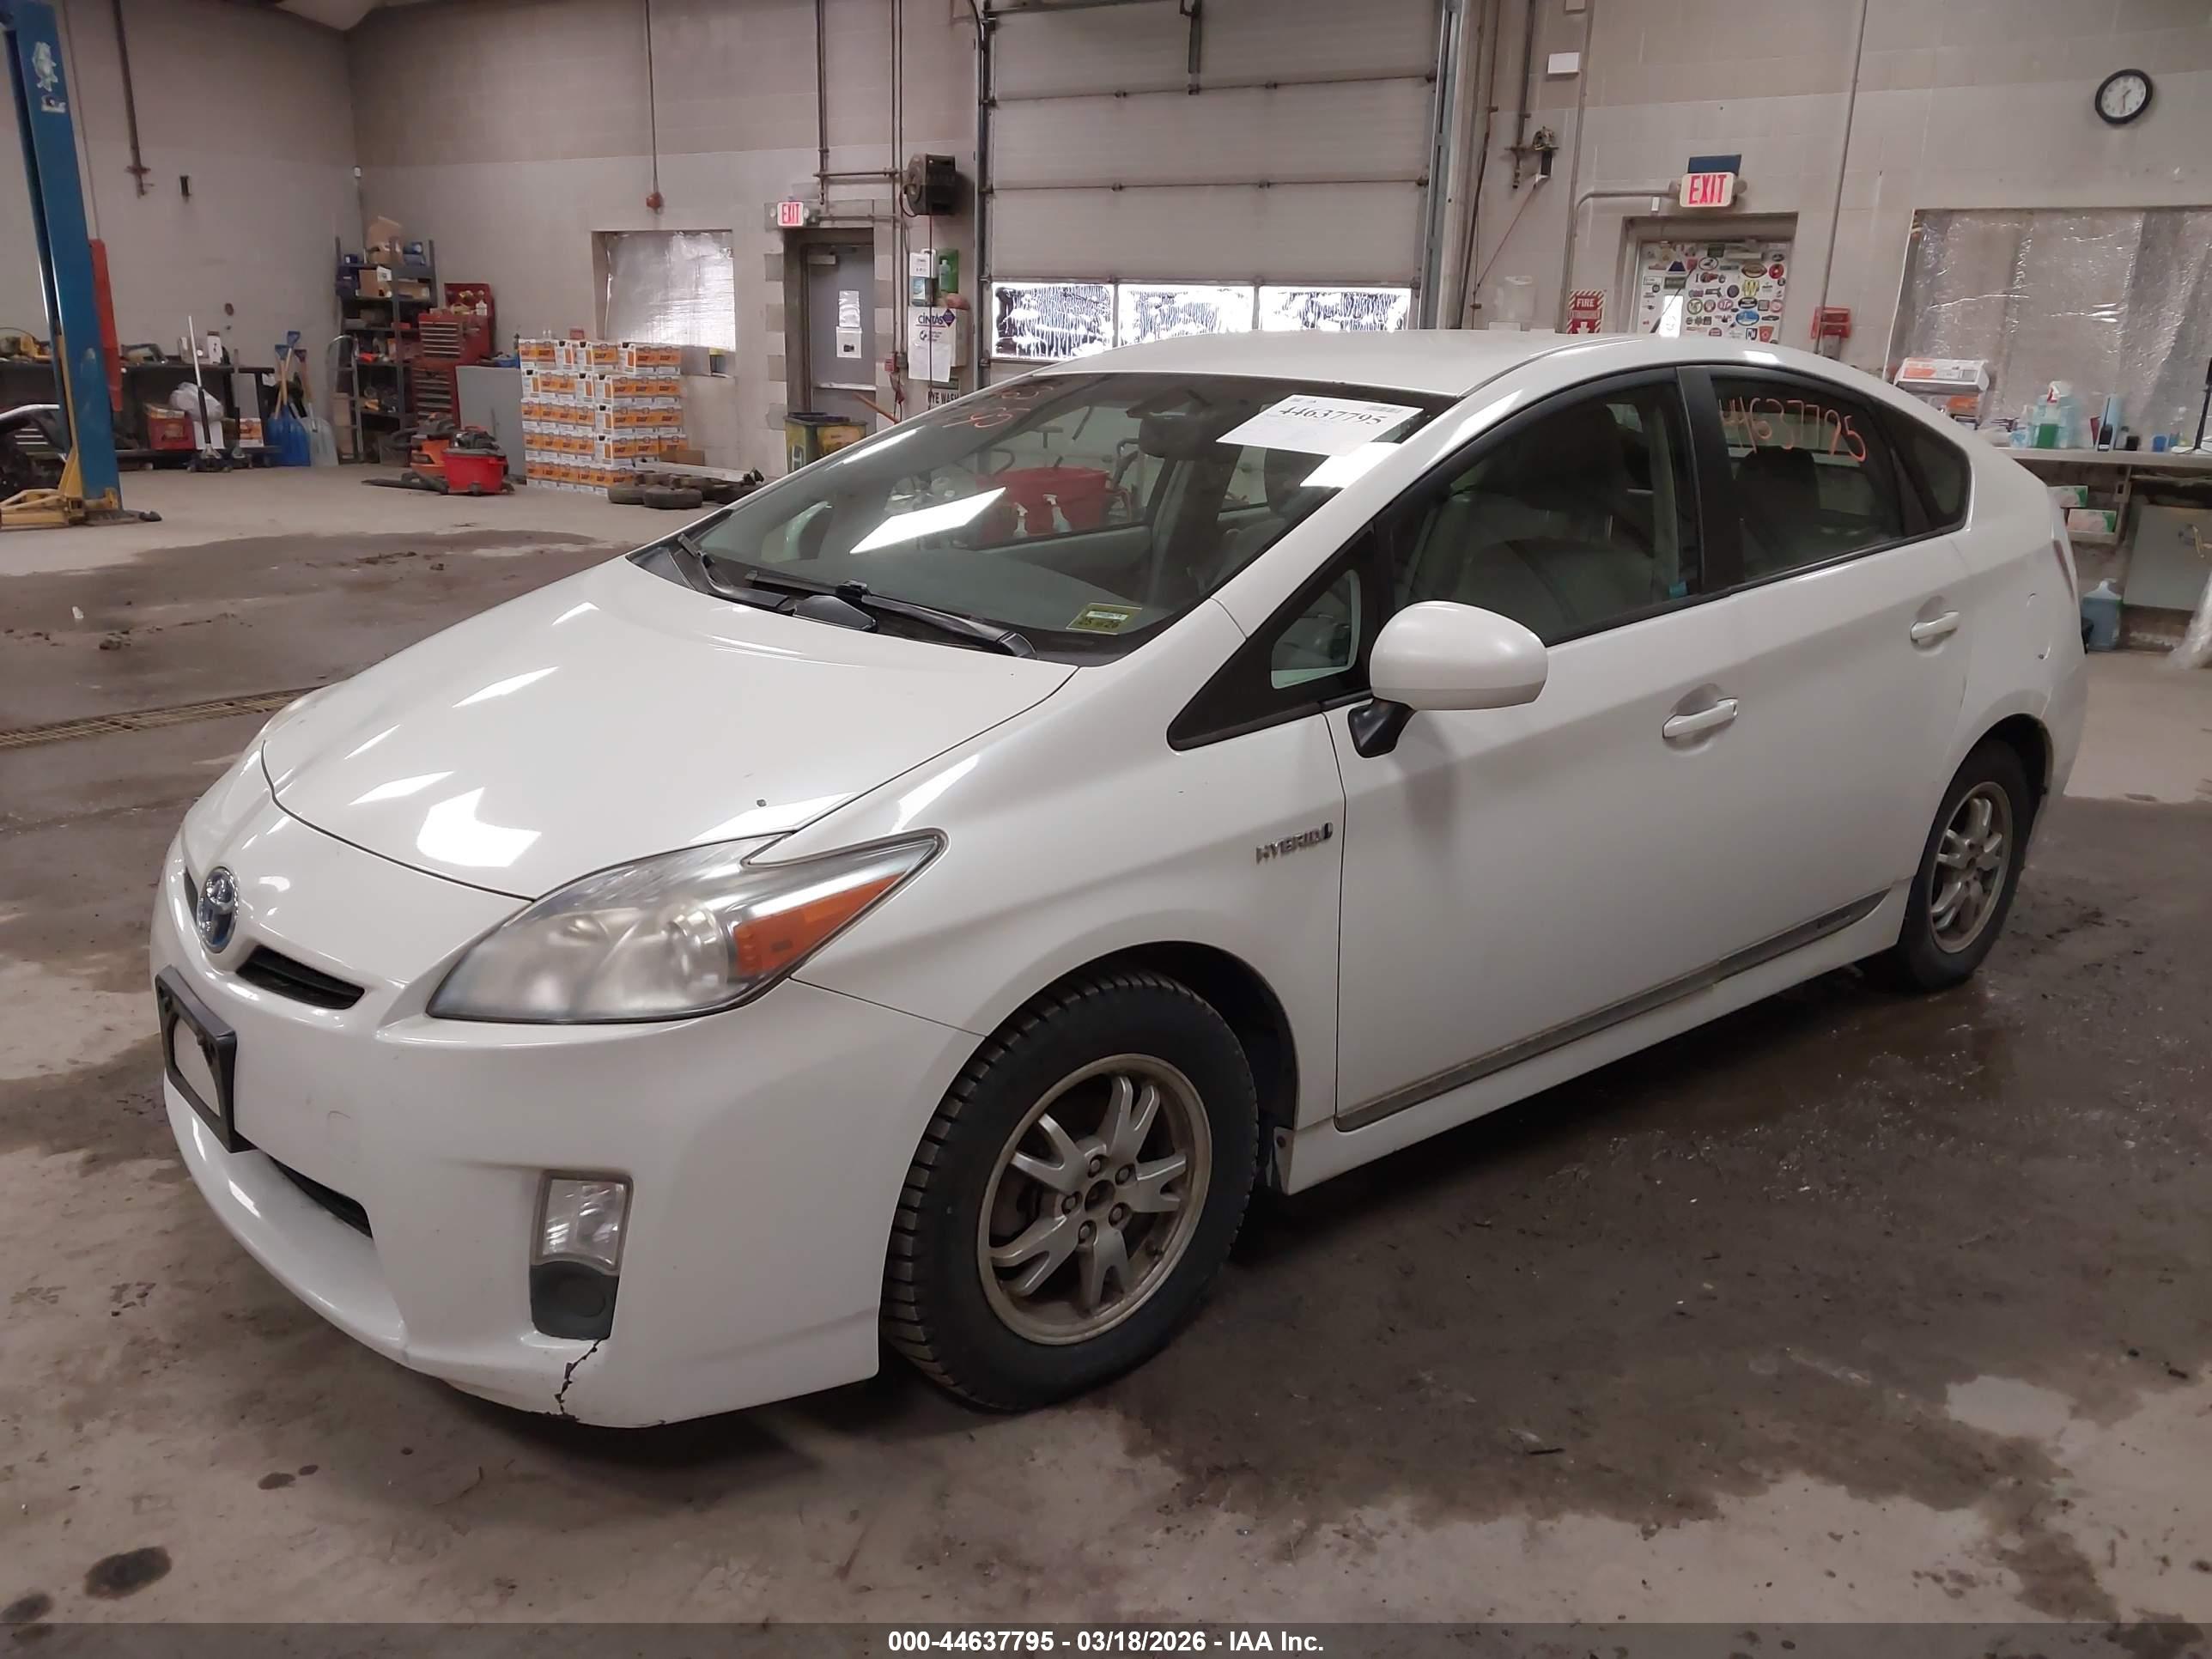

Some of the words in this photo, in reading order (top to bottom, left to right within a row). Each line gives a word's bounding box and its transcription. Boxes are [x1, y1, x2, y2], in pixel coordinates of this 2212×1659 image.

[1688, 174, 1727, 204] EXIT
[781, 204, 800, 224] EXIT
[1576, 298, 1595, 307] FIRE
[1279, 405, 1388, 425] 44637795
[1719, 397, 1866, 462] 44637795
[1255, 829, 1321, 865] HYBRID
